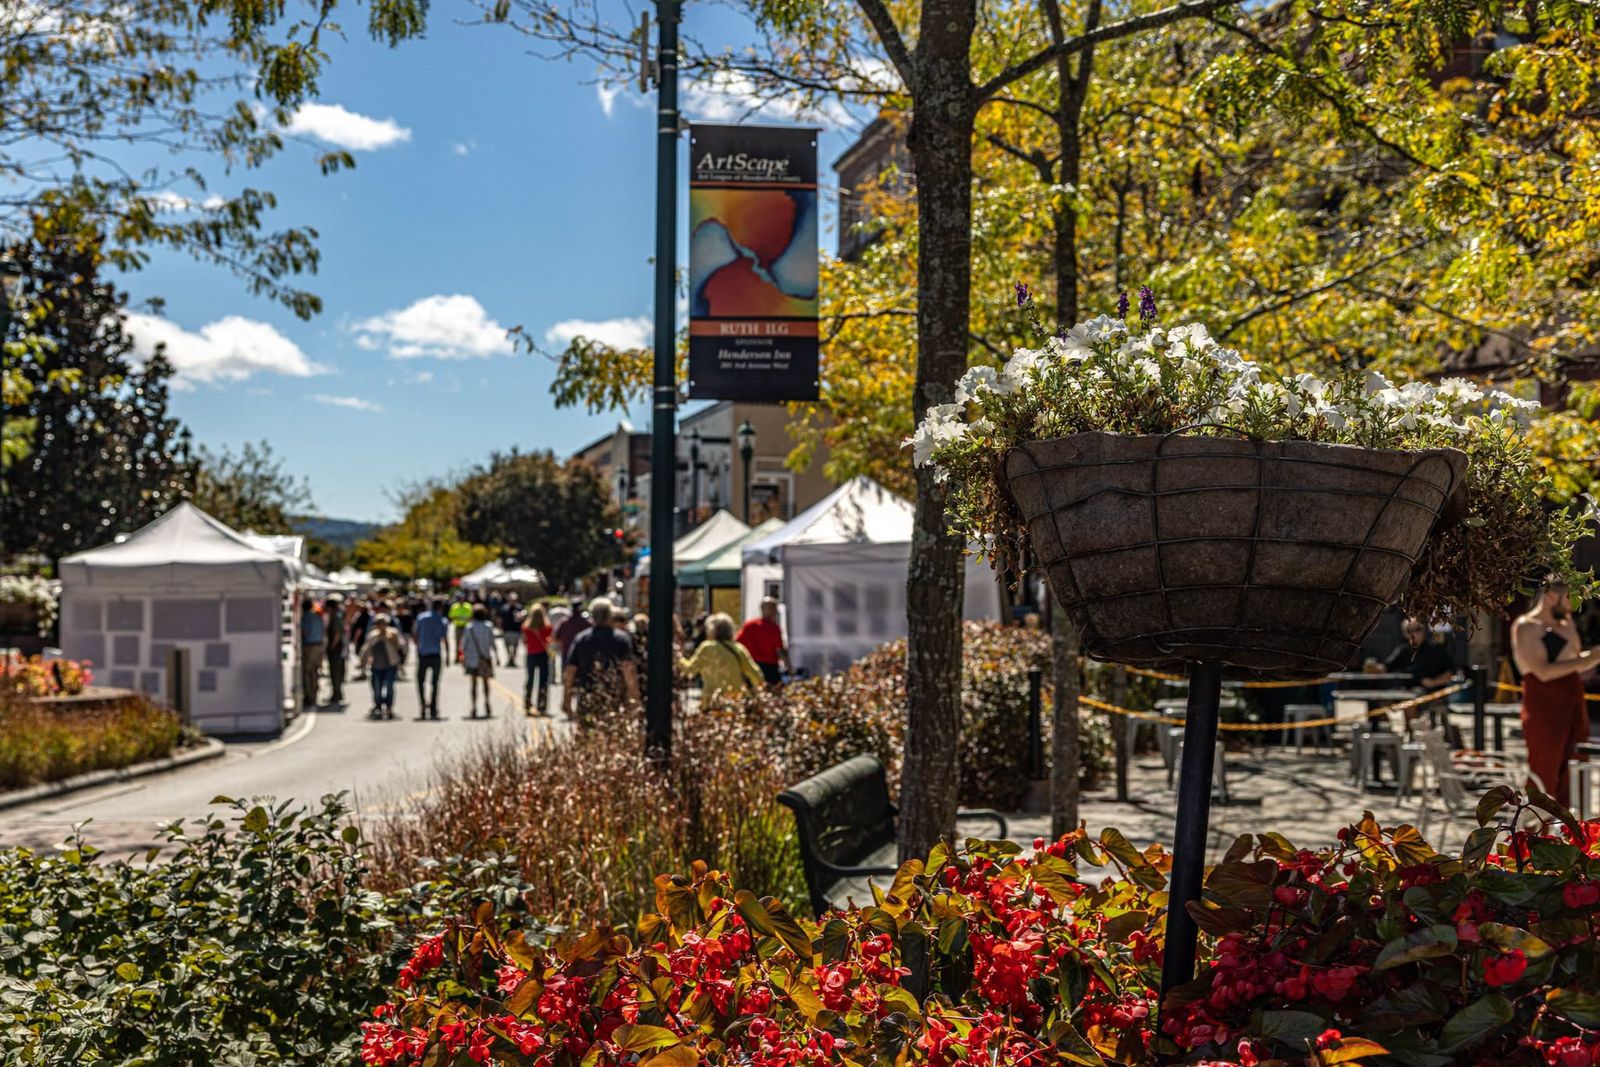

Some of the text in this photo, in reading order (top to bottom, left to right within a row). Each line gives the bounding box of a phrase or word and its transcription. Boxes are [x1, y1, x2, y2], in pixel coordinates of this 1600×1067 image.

[697, 153, 789, 175] ArtScape
[719, 322, 789, 335] RUTH ILG
